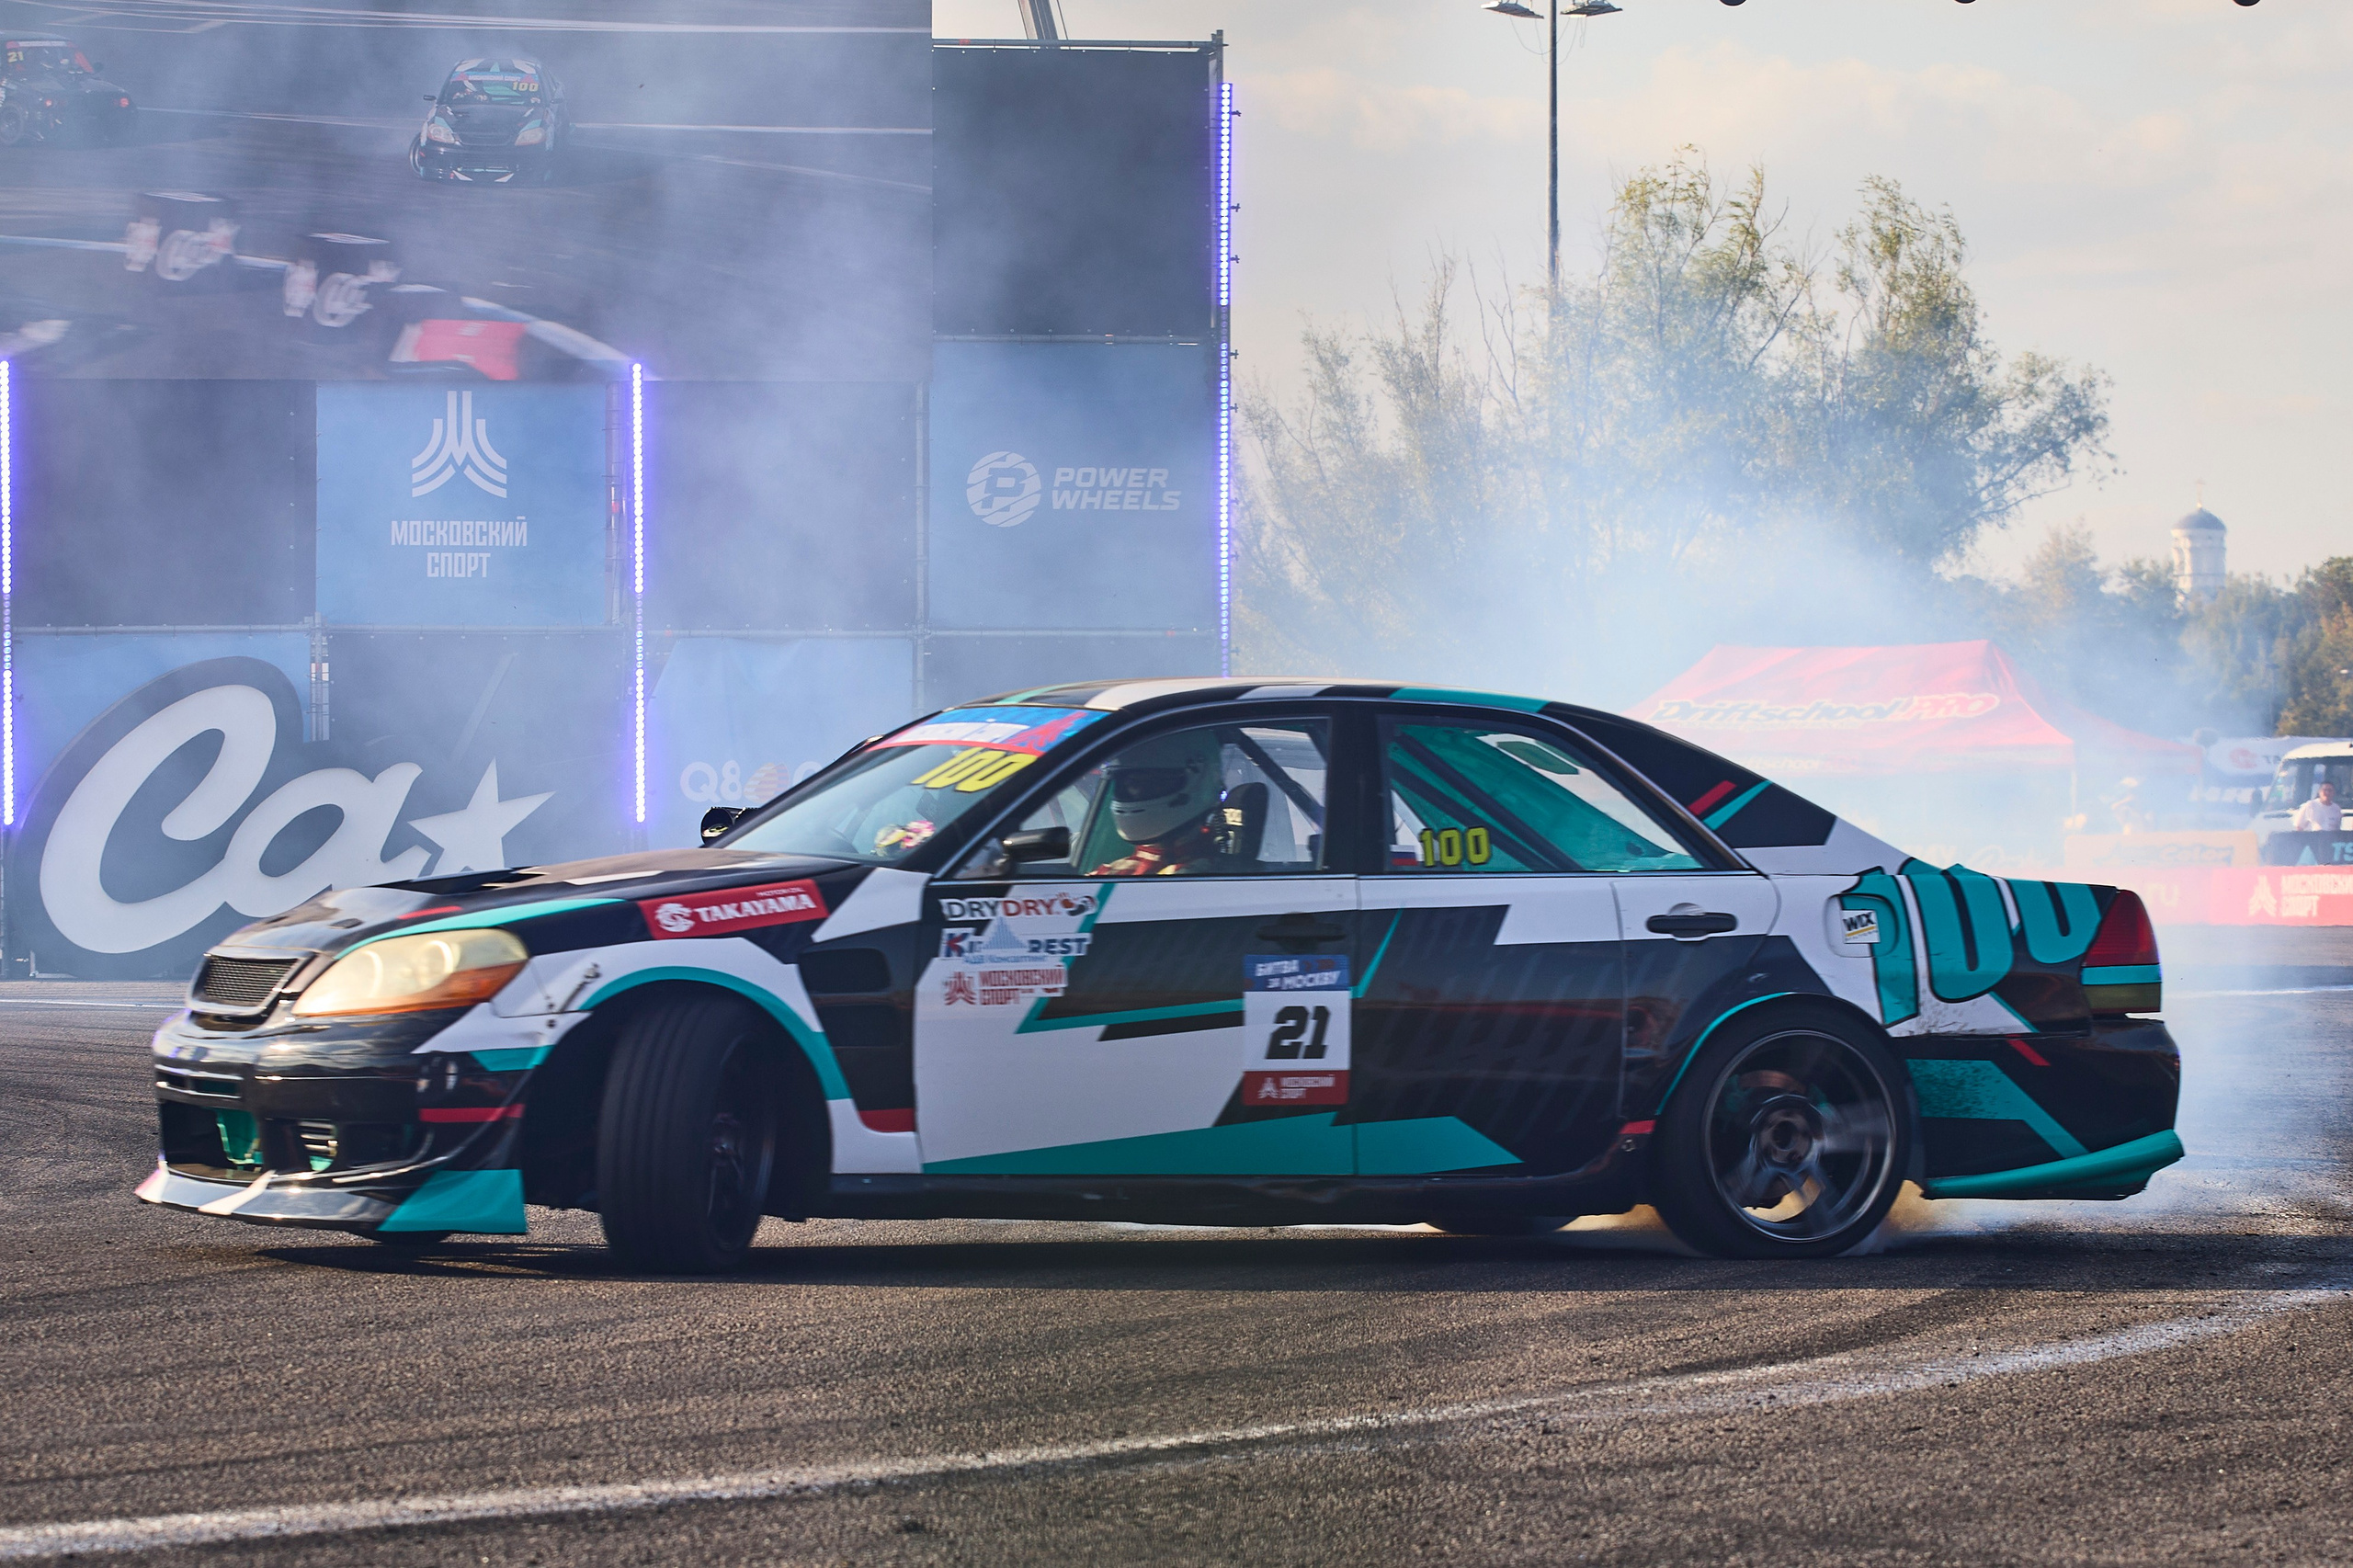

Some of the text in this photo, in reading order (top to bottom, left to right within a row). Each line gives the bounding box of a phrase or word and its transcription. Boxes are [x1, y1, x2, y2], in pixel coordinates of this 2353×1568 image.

[7, 51, 24, 62] 21
[512, 81, 539, 92] 100
[1053, 467, 1169, 488] POWER
[1052, 490, 1182, 511] WHEELS
[391, 516, 528, 547] МОСКОВСКИЙ
[426, 552, 491, 578] СПОРТ
[680, 760, 743, 802] Q8
[909, 746, 1040, 793] 100
[1419, 826, 1491, 867] 100
[694, 894, 817, 922] TAKAYAMA
[1843, 912, 1876, 931] WIX
[979, 964, 1063, 987] МОСКОВСКИЙ
[1265, 1006, 1331, 1060] 21
